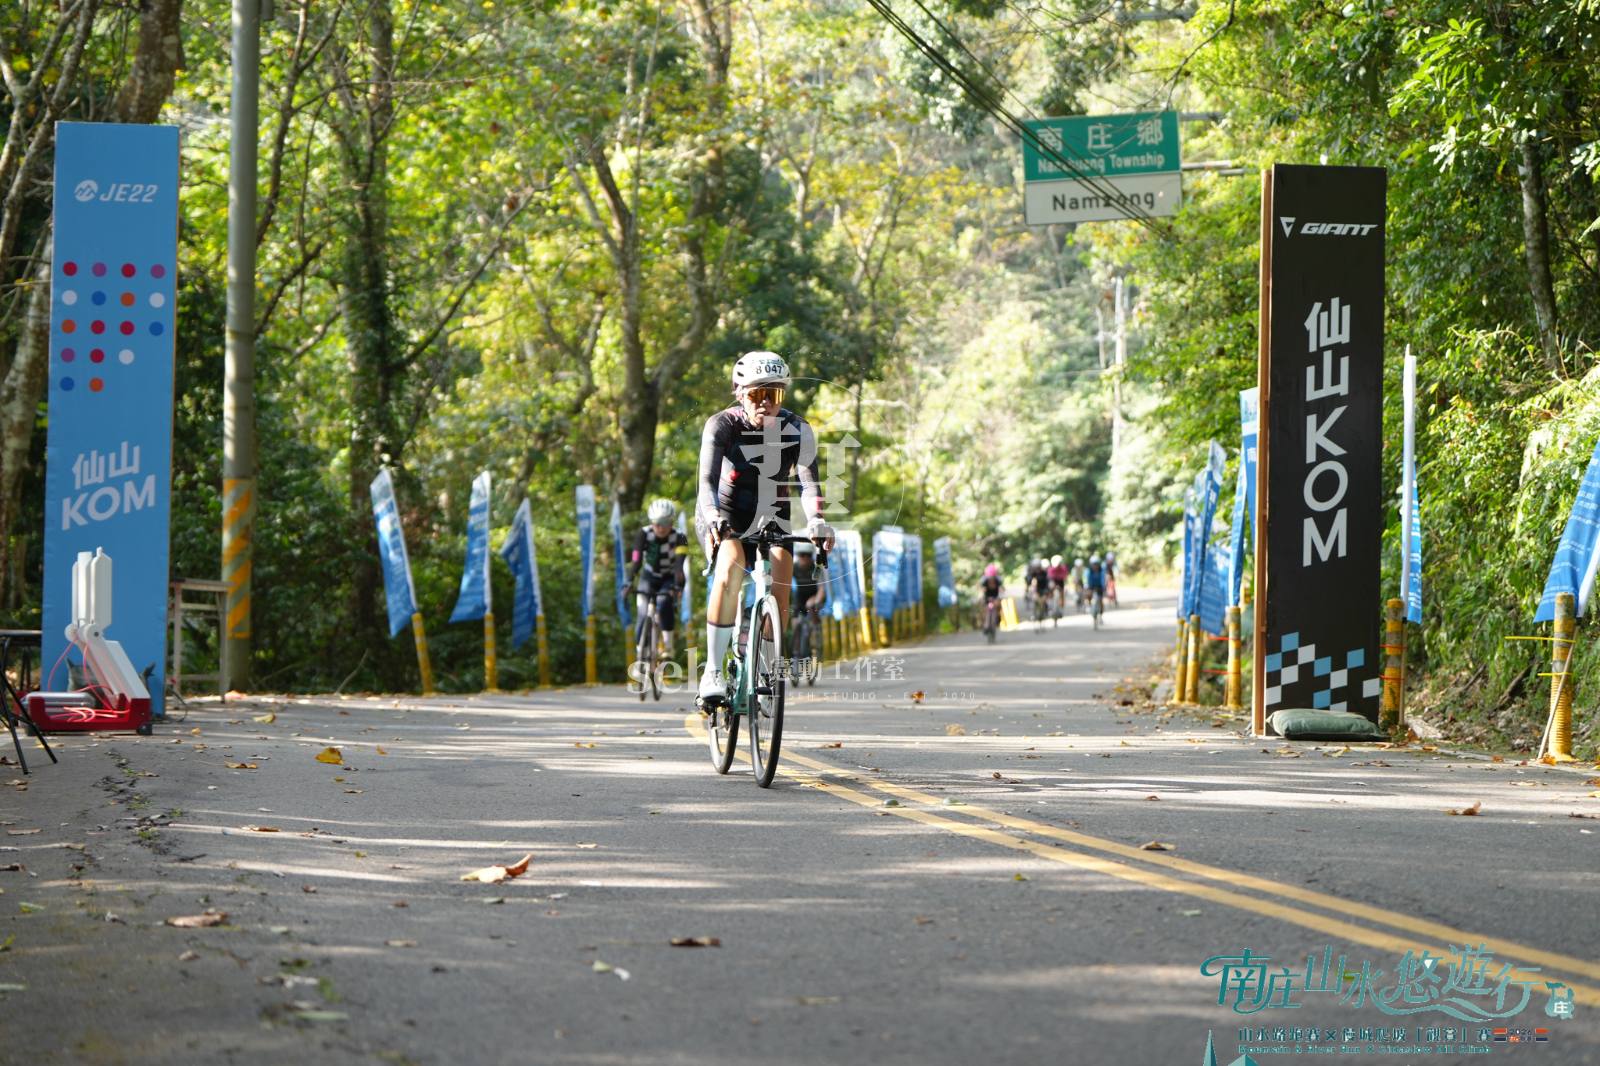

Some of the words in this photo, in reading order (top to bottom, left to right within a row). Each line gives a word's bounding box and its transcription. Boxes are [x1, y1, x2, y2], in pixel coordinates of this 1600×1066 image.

[1110, 154, 1165, 168] Township
[99, 183, 158, 202] JE22
[1300, 222, 1378, 236] GIANT
[1304, 296, 1350, 401] 仙山
[765, 364, 782, 374] 047
[72, 441, 140, 489] 仙山
[61, 474, 155, 530] KOM
[1303, 405, 1348, 567] KOM
